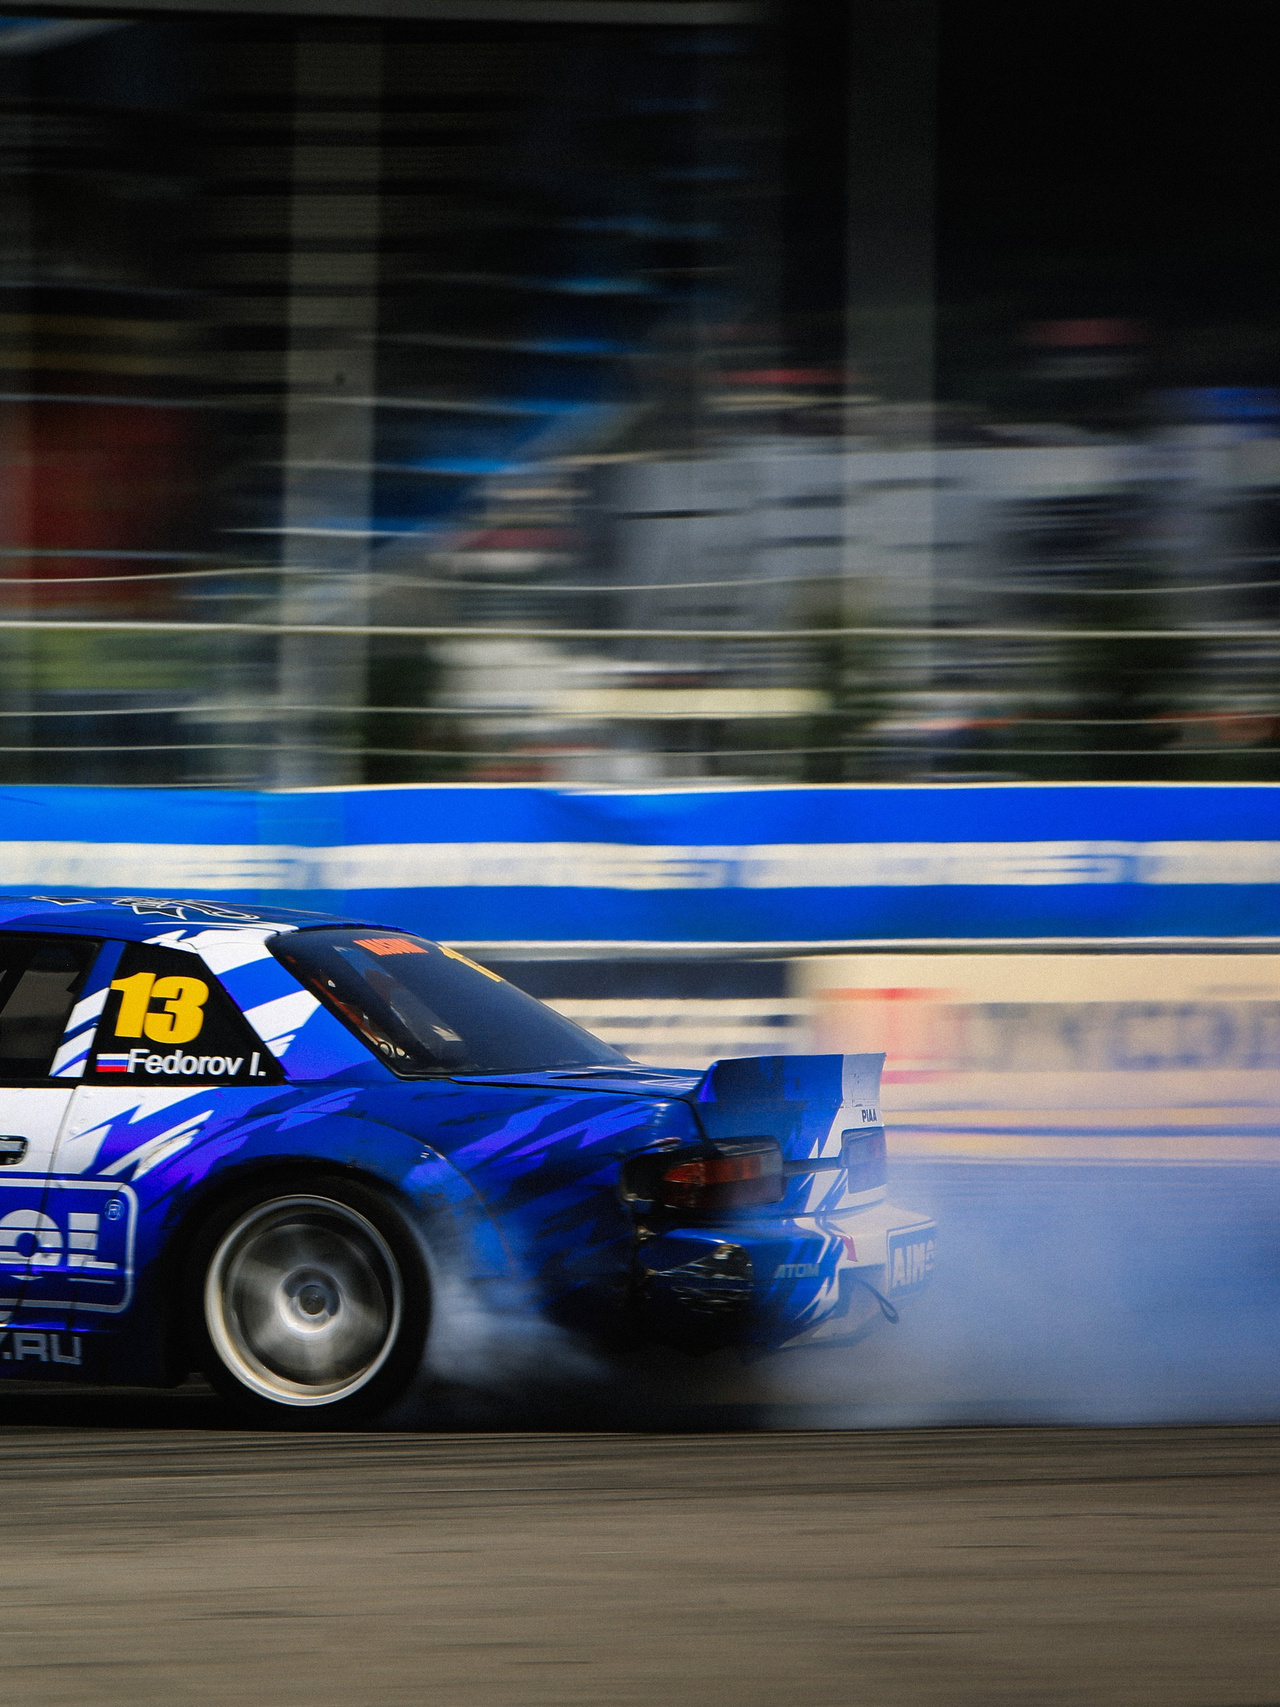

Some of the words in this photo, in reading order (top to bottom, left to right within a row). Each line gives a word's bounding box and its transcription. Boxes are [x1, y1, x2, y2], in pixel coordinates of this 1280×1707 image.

[110, 972, 209, 1044] 13
[126, 1048, 244, 1076] Fedorov
[249, 1051, 267, 1077] I.
[861, 1108, 877, 1122] PIAA
